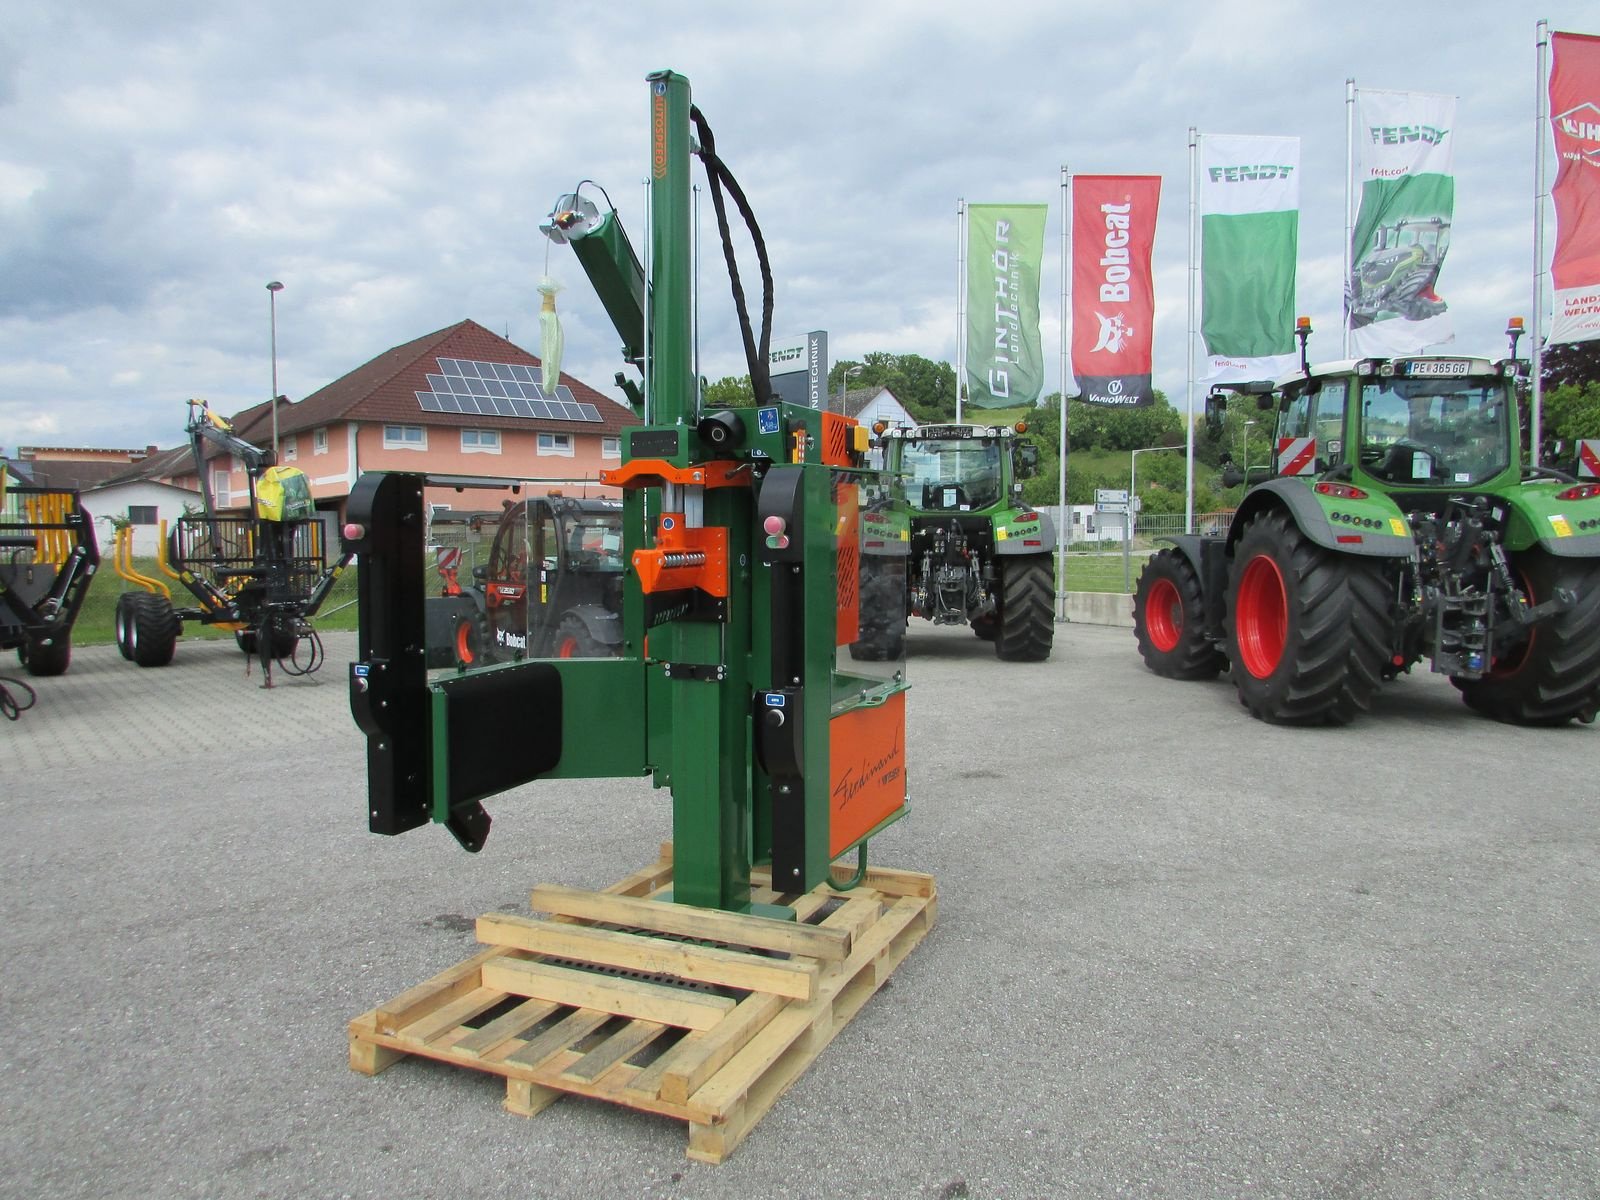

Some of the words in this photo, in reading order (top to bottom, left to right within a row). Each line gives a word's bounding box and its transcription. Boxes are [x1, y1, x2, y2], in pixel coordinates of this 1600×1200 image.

[655, 96, 664, 165] AUTOSPEED
[1369, 125, 1449, 147] FENDT
[1208, 165, 1294, 183] FENDT
[1100, 203, 1131, 303] Bobcat
[988, 220, 1010, 398] GINTHÖR
[1413, 363, 1426, 373] PE
[1432, 363, 1451, 373] 365
[1452, 363, 1465, 373] GG
